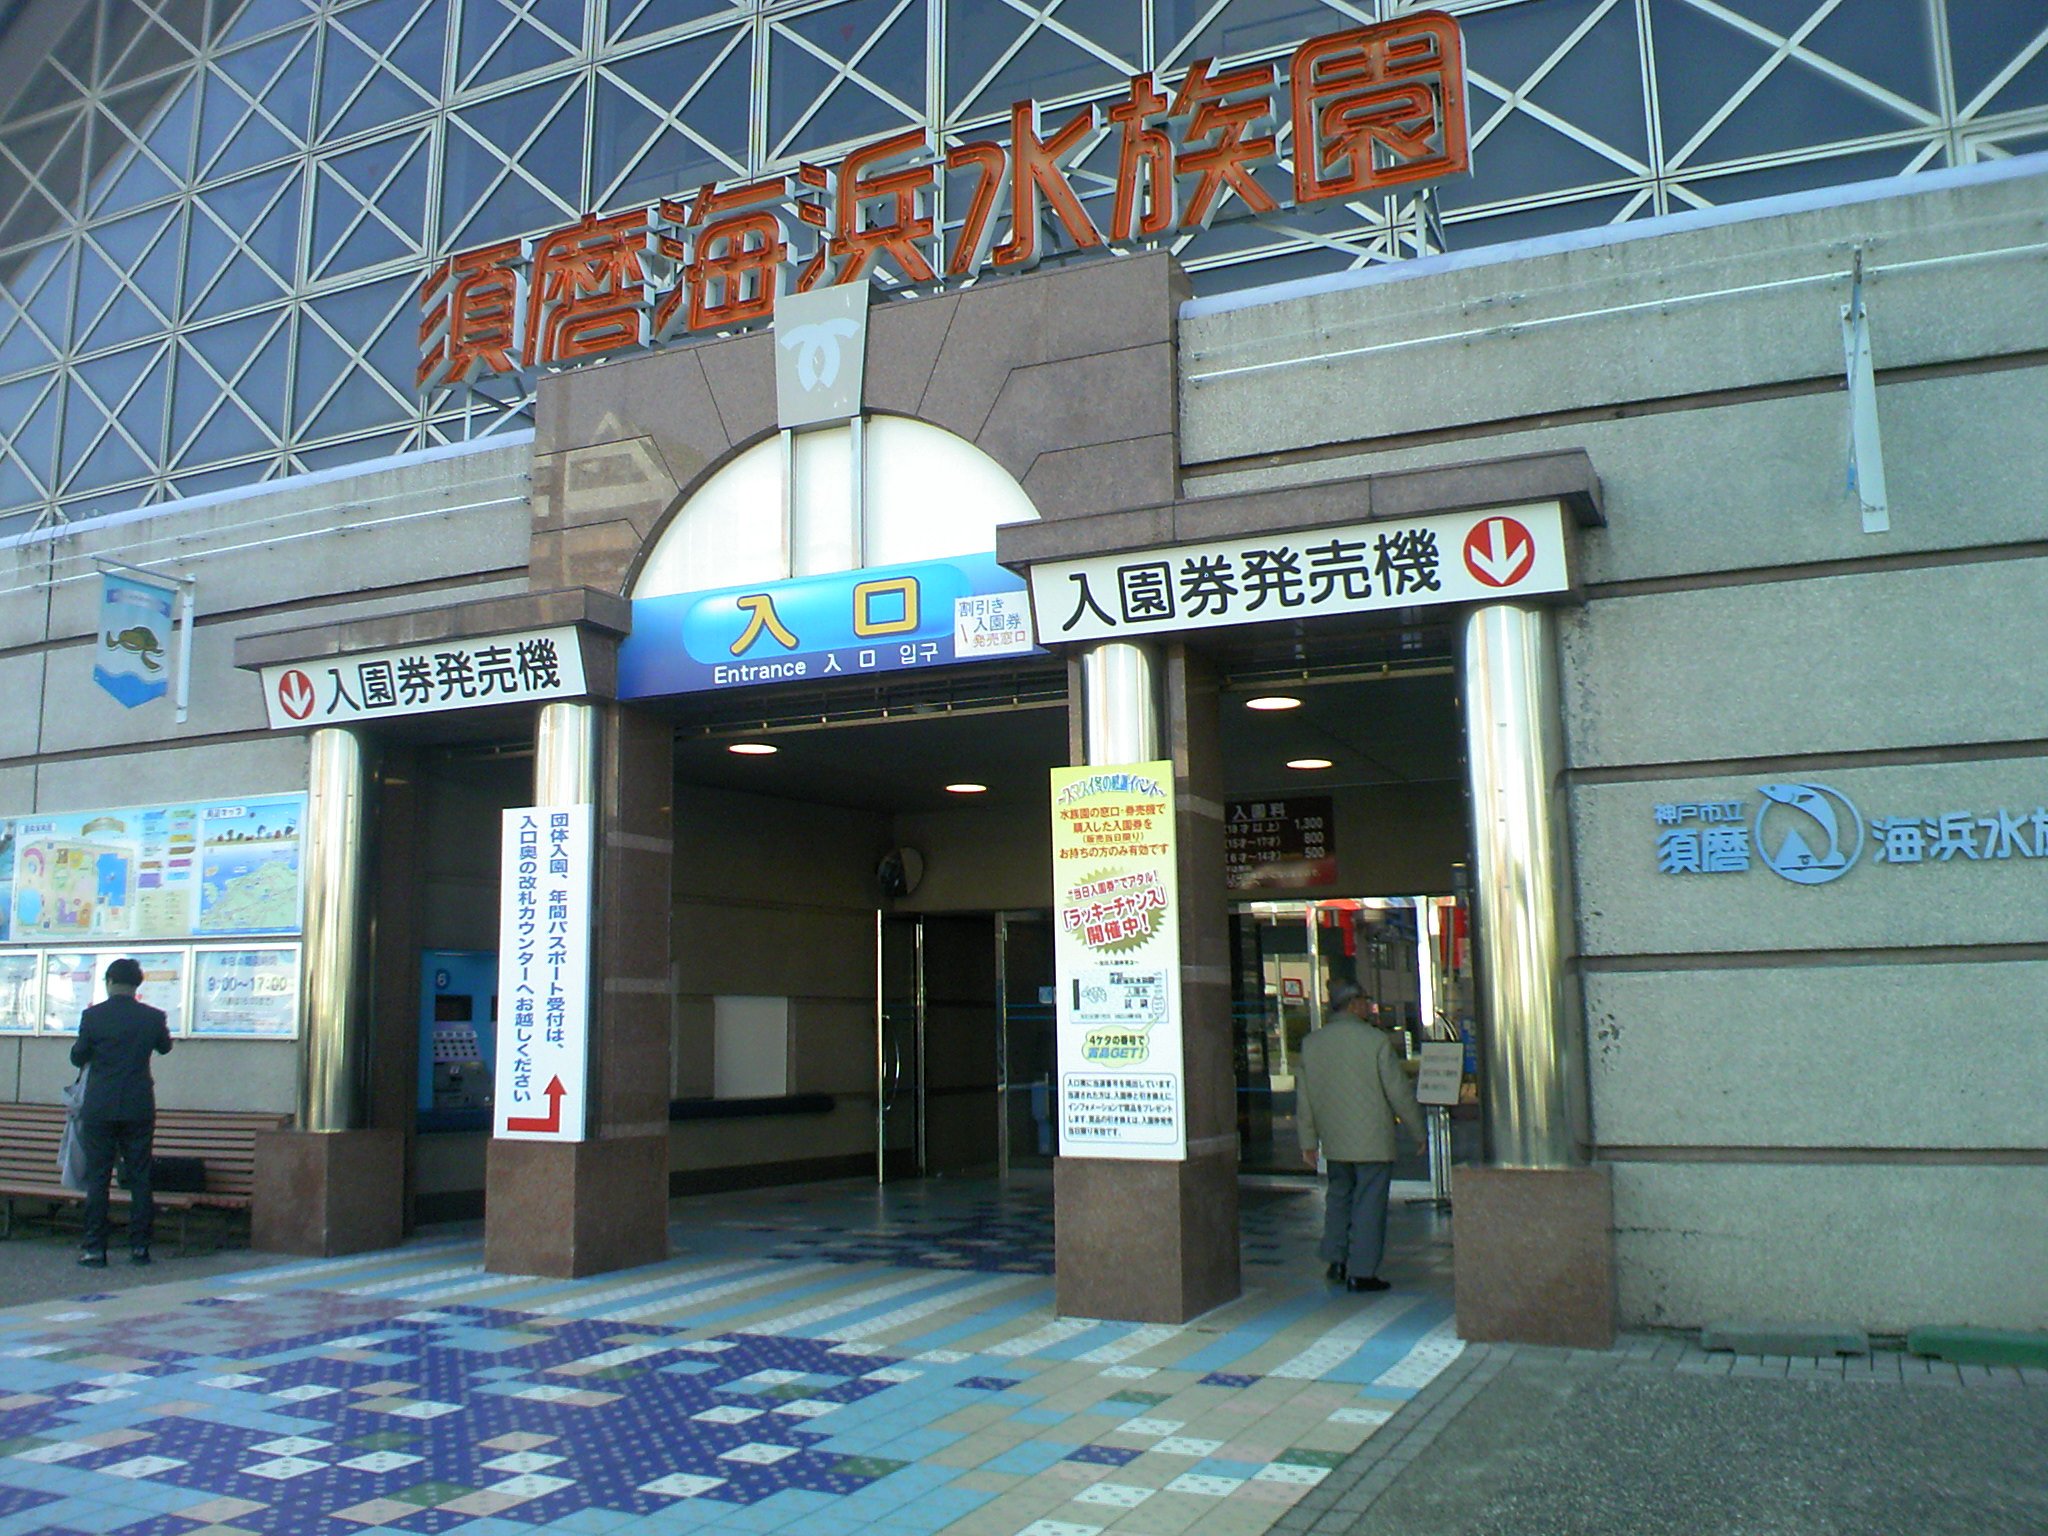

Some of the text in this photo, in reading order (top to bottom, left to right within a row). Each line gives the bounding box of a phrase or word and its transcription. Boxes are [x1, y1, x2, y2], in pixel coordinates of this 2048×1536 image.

[416, 9, 1473, 392] 須磨海浜水族園
[1062, 528, 1442, 632] 入園券発売機
[730, 576, 922, 657] 入口
[959, 598, 1004, 618] 割引き
[973, 613, 1022, 633] 入園券
[714, 659, 807, 685] Entrance
[900, 642, 938, 665] 입구
[973, 631, 1026, 648] 発売窓口
[326, 637, 562, 716] 入園券発売機
[1654, 801, 1745, 825] 神戸市立
[1059, 842, 1169, 860] お持ちの方のみ有効です
[1655, 825, 1750, 875] 須磨
[545, 812, 570, 1050] 団体入園、年間パスポート受付は、
[513, 814, 539, 1104] 入口奥の改札カウンターへお越しください
